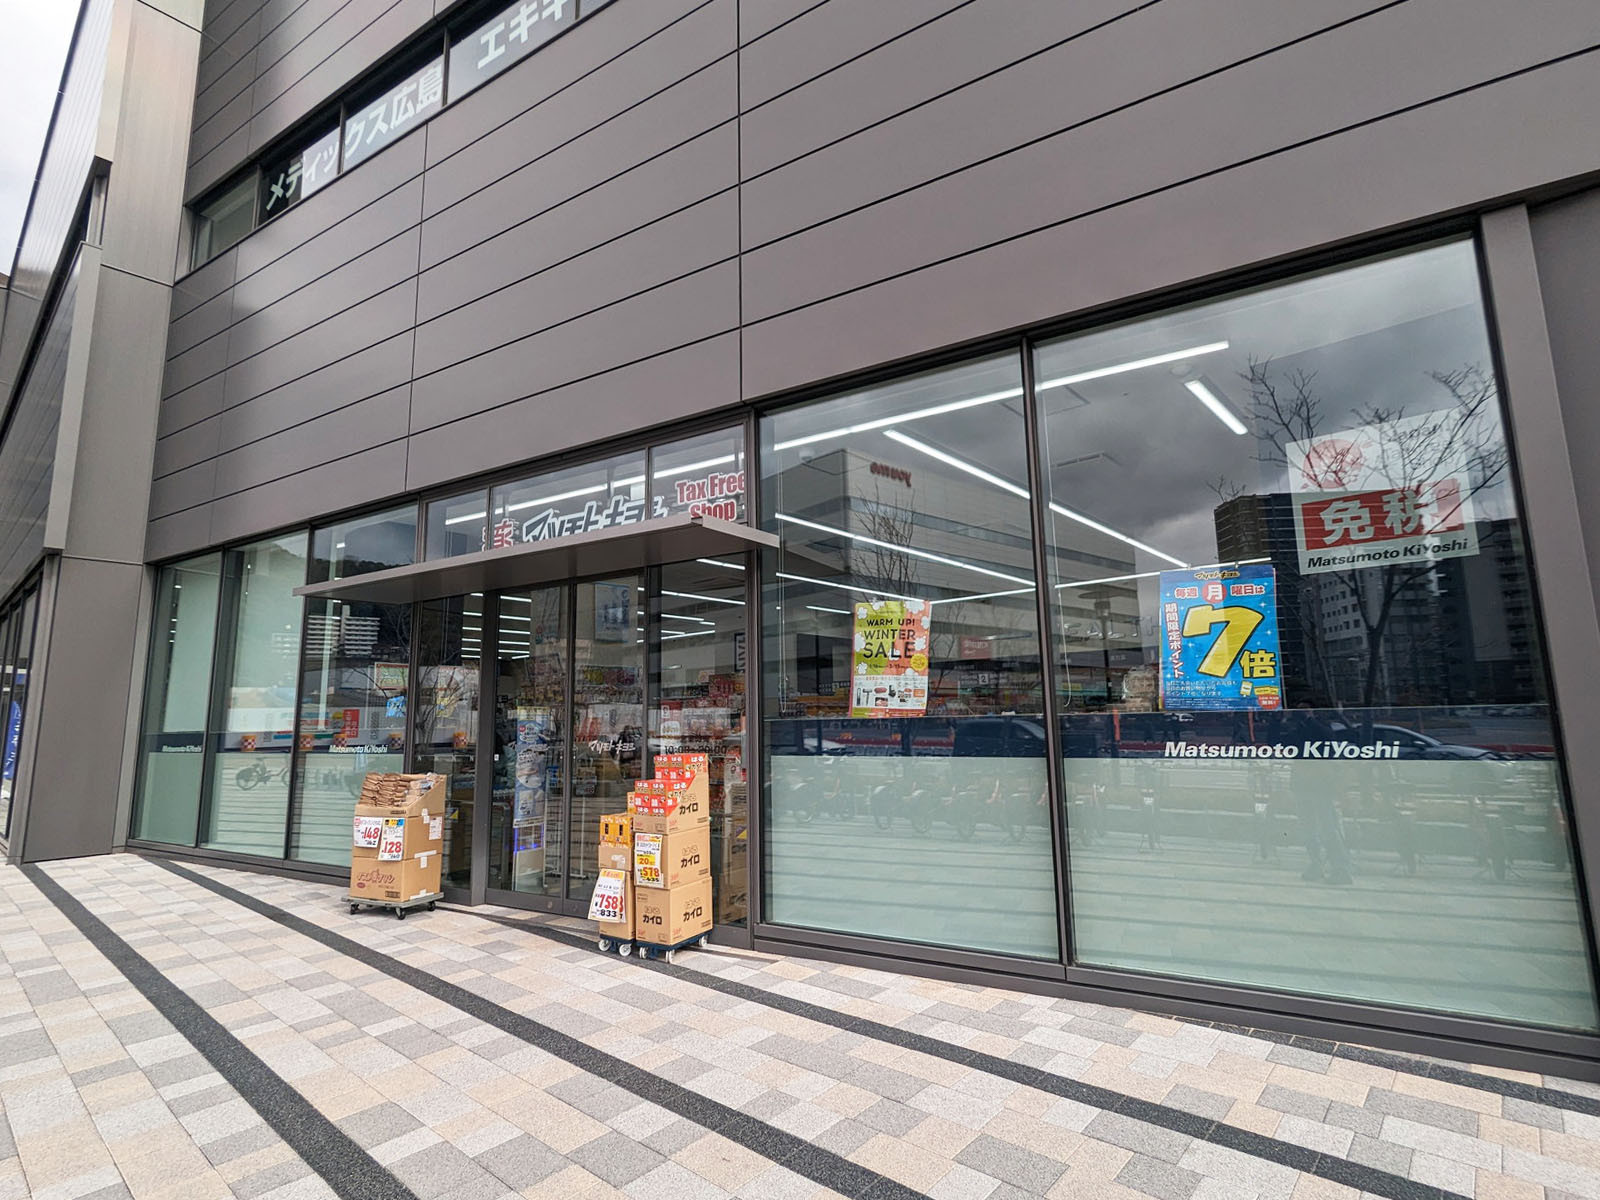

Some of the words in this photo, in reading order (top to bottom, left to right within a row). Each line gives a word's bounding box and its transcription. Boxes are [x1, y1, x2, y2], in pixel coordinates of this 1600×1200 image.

[677, 480, 707, 504] Tax
[708, 471, 745, 498] Free
[1307, 549, 1400, 568] Matsumoto
[1403, 538, 1468, 558] KiYoshi
[1207, 584, 1223, 600] 月
[867, 618, 894, 626] WARM
[898, 618, 915, 626] UP!
[863, 629, 916, 640] WINTER
[863, 641, 916, 659] SALE
[1164, 741, 1298, 758] Matsumoto
[1302, 740, 1400, 759] KiYoshi
[679, 802, 699, 816] カイロ
[364, 827, 380, 840] 148
[384, 841, 402, 853] 128
[639, 857, 649, 865] 20
[680, 855, 700, 868] カイロ
[643, 867, 660, 877] 578
[599, 894, 618, 910] 758
[600, 908, 617, 917] 833
[683, 906, 702, 922] カイロ
[642, 914, 662, 926] カイロ
